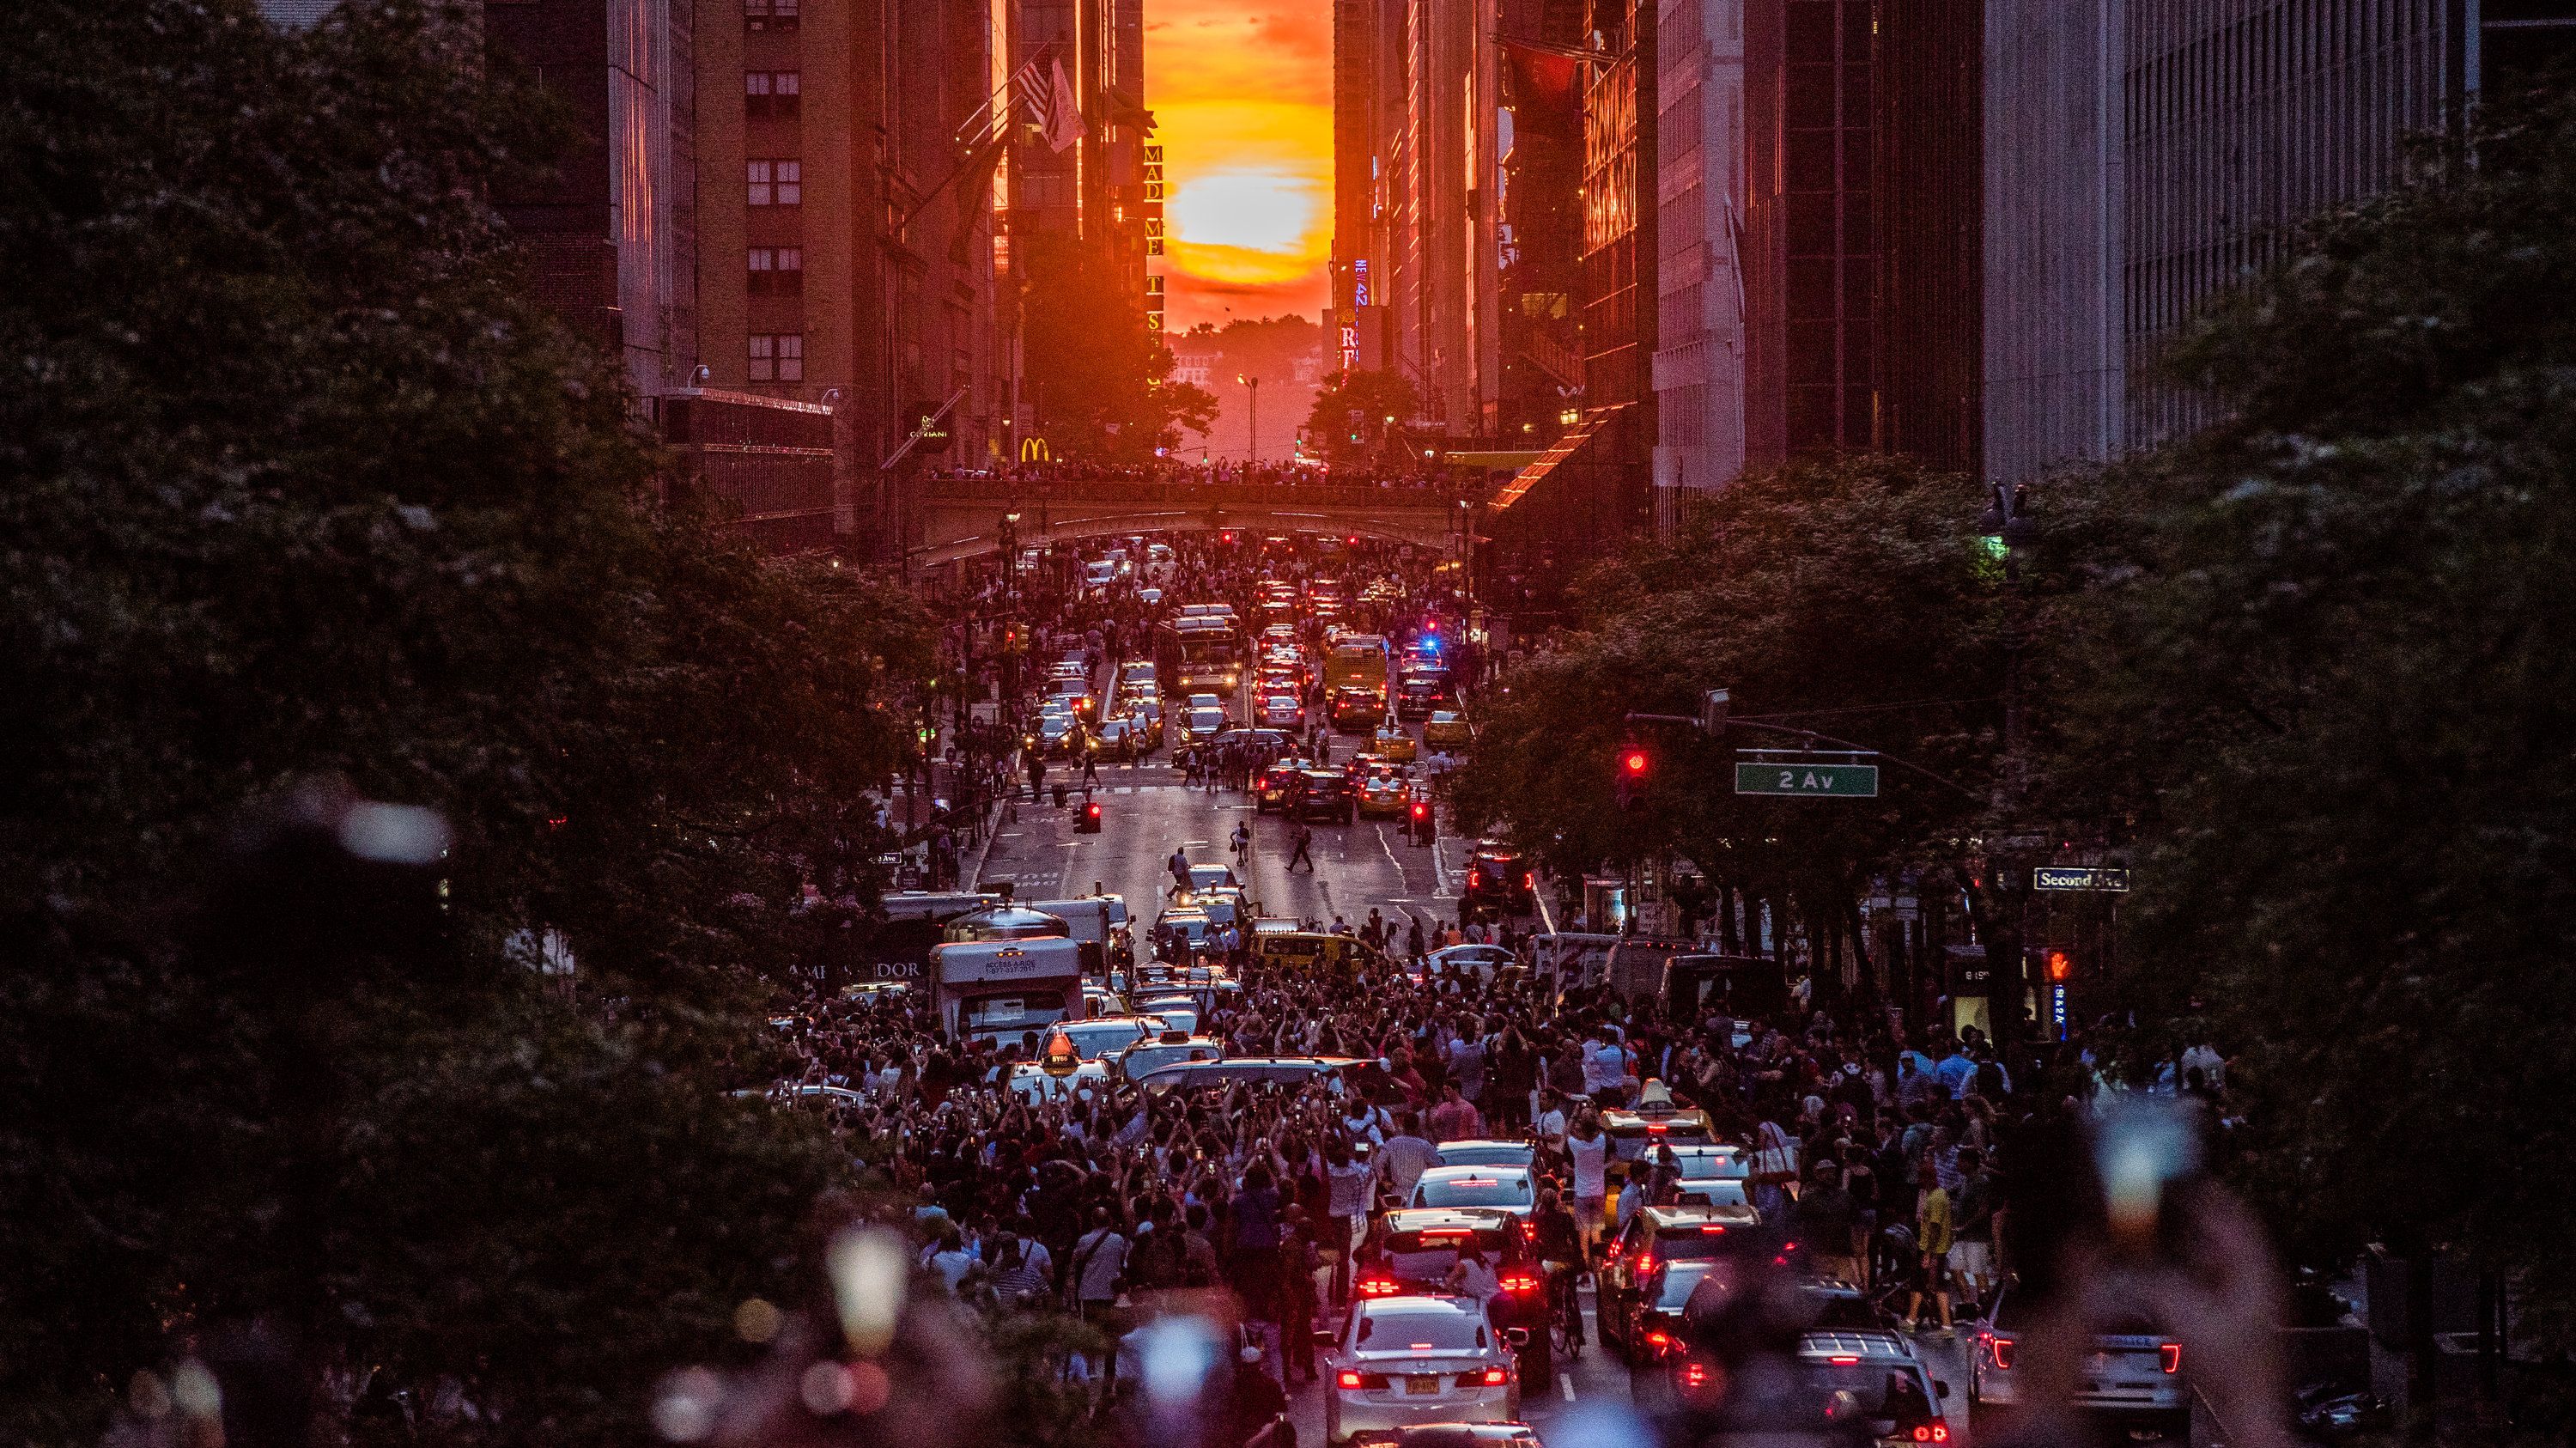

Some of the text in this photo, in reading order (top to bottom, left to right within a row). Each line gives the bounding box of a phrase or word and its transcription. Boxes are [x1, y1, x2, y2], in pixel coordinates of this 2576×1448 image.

[1145, 147, 1161, 255] MADME
[1355, 259, 1366, 282] NEW
[1780, 771, 1833, 789] 2 Av
[2041, 873, 2092, 886] Second
